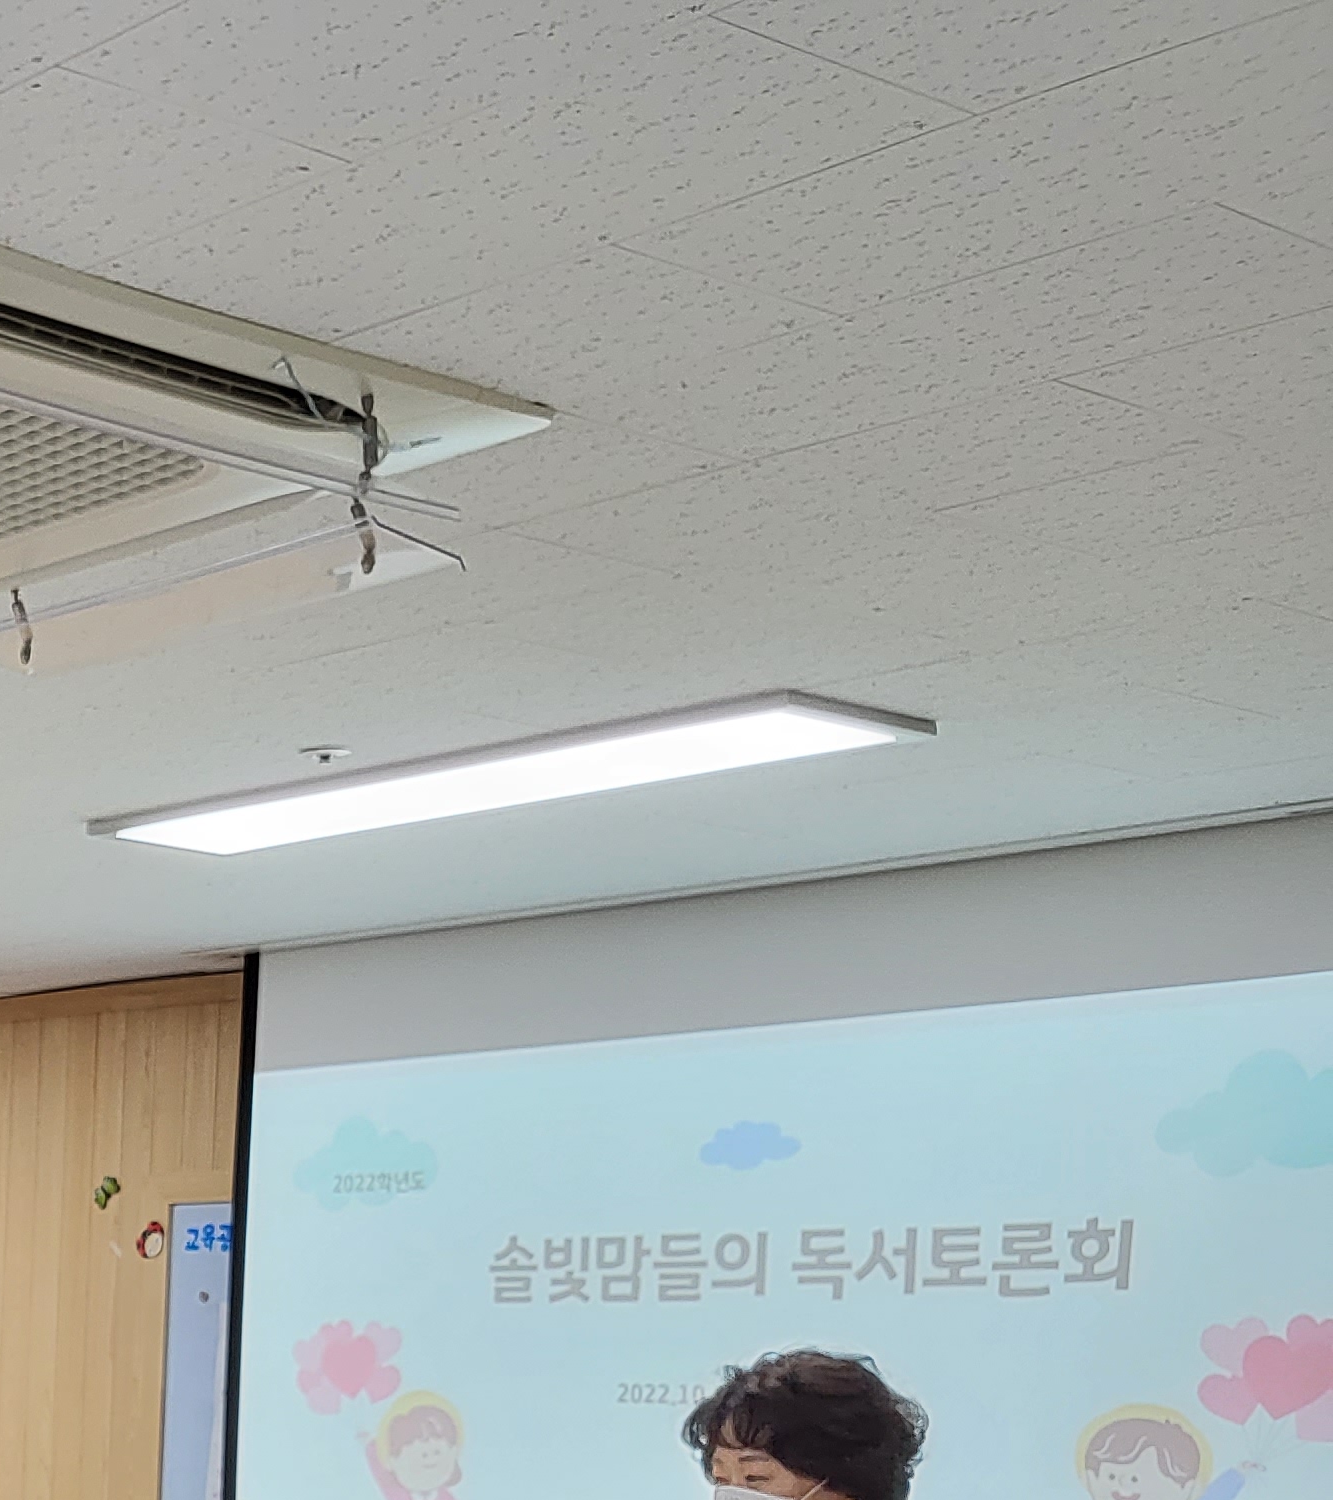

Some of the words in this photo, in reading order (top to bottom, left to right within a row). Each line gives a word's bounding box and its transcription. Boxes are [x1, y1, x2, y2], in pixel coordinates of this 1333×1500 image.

[332, 1170, 426, 1194] 2022학년도
[488, 1231, 770, 1304] 솔빛맘들의
[791, 1217, 1135, 1301] 독서토론회
